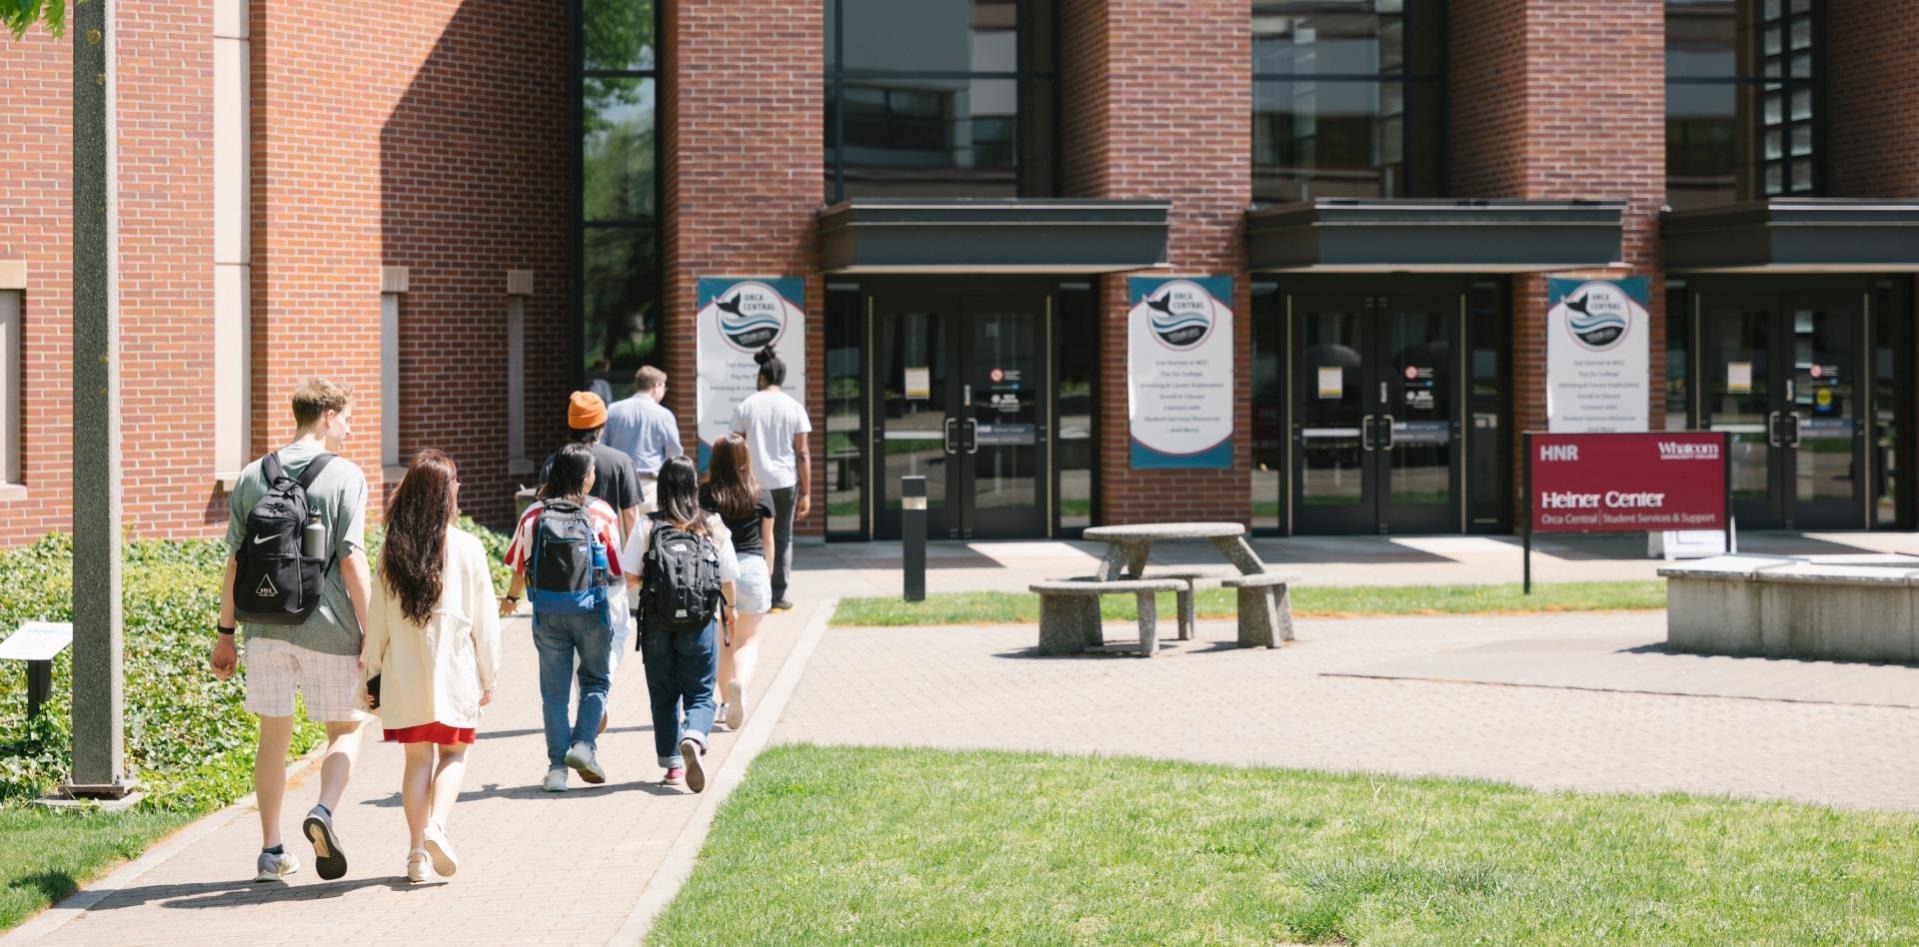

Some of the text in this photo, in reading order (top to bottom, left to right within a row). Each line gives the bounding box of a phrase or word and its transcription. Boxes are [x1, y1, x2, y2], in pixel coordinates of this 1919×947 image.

[743, 293, 764, 301] ORCA
[1174, 292, 1193, 300] ORCA
[743, 303, 776, 312] CENTRAL
[1173, 302, 1204, 310] CENTRAL
[1590, 303, 1621, 311] CENTRAL
[1540, 444, 1579, 461] HNR
[1658, 441, 1719, 456] Whatcom
[1542, 490, 1665, 509] Heiner Center
[1542, 513, 1598, 525] Orca Central
[1602, 512, 1715, 525] Student Services & Support
